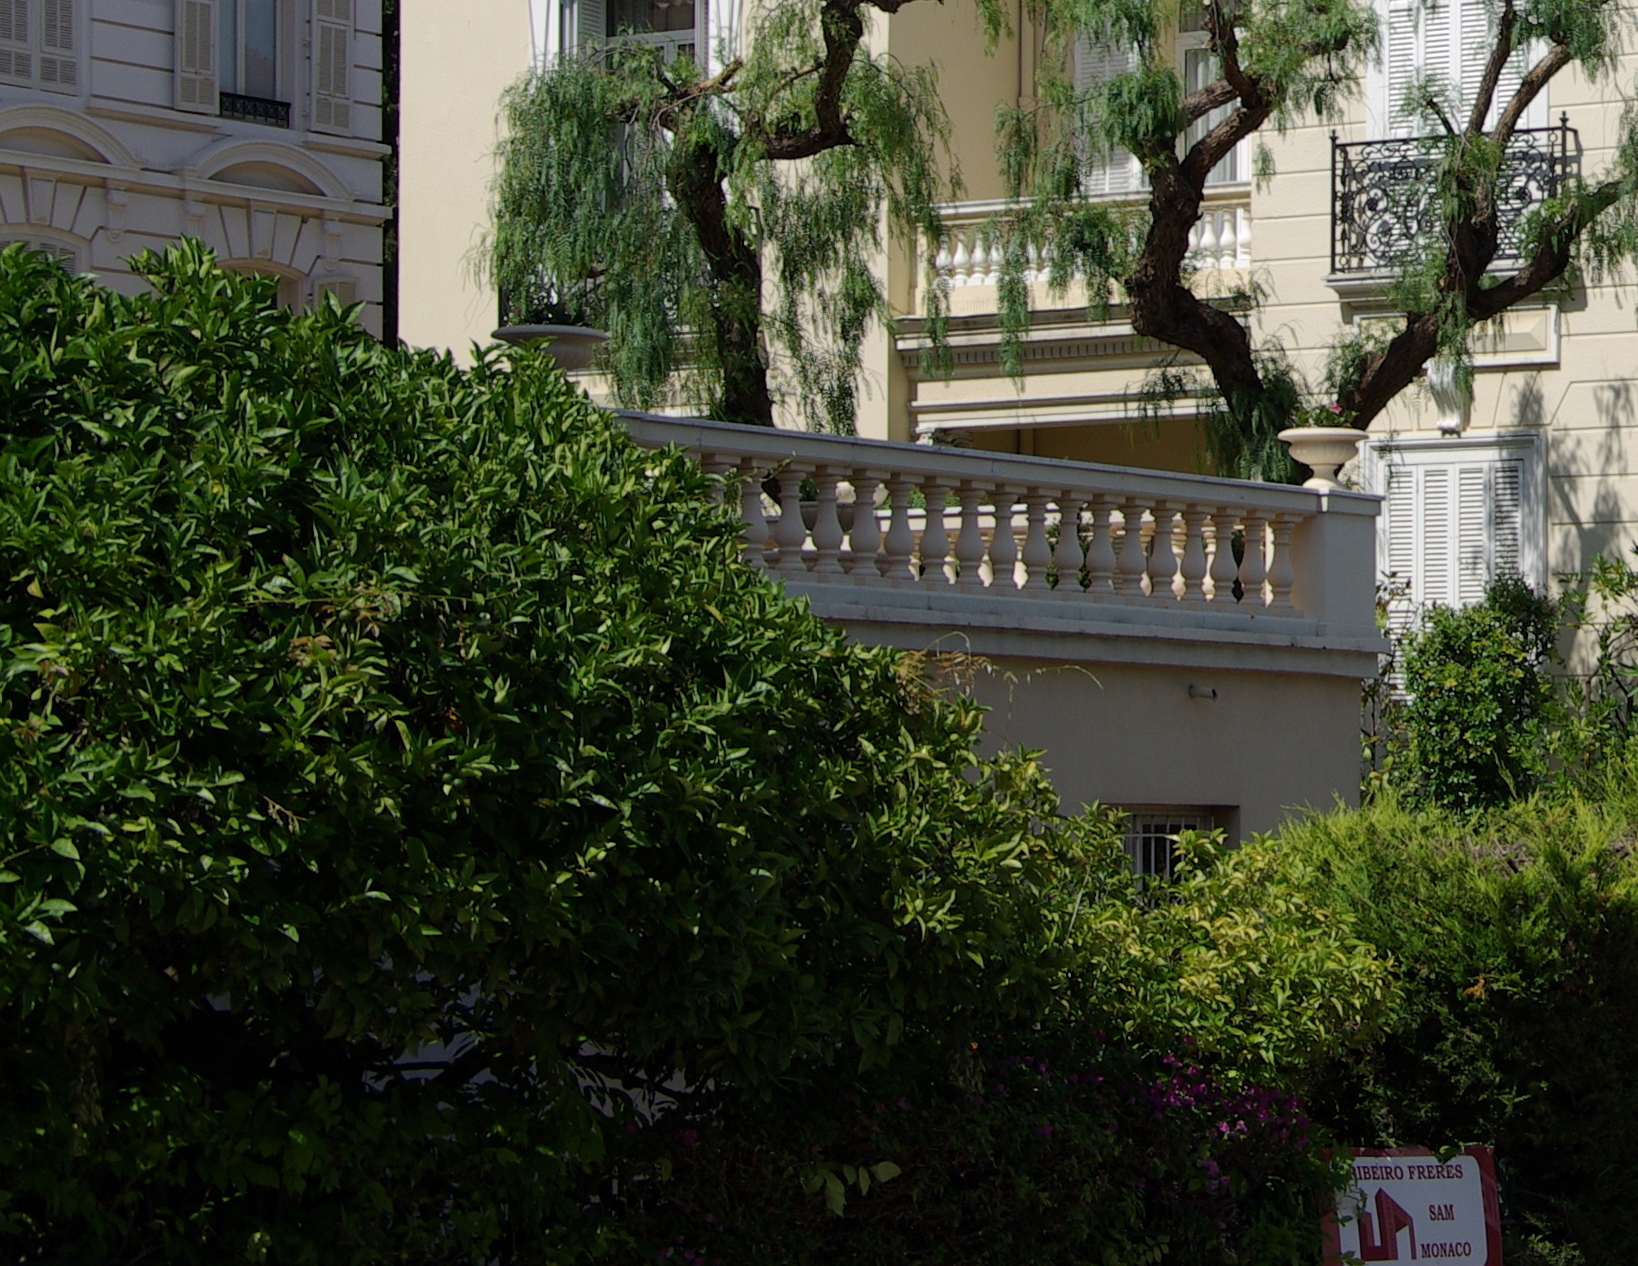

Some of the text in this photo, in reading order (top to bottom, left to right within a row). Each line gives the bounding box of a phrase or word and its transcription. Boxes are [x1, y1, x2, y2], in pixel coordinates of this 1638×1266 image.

[1408, 1164, 1463, 1180] FRERES
[1429, 1204, 1455, 1221] SAM
[1421, 1242, 1471, 1259] MONACO
